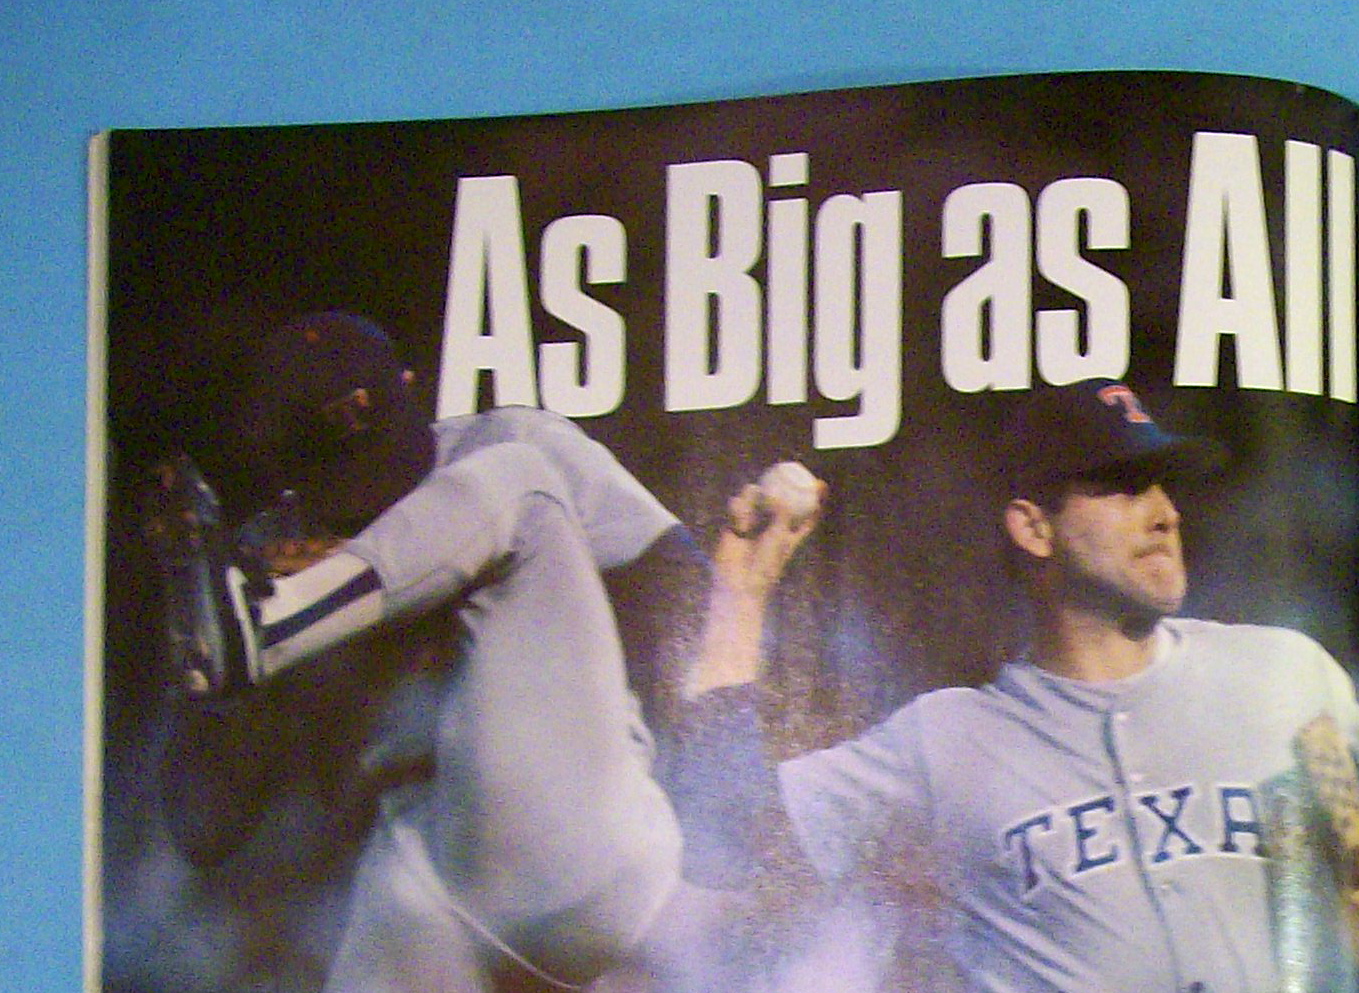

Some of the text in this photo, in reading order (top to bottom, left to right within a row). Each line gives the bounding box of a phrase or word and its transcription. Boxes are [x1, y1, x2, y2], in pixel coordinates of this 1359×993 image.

[436, 174, 628, 421] As
[664, 152, 902, 449] Big
[941, 177, 1131, 392] as
[1173, 131, 1358, 404] All
[1004, 785, 1270, 894] TEXA
